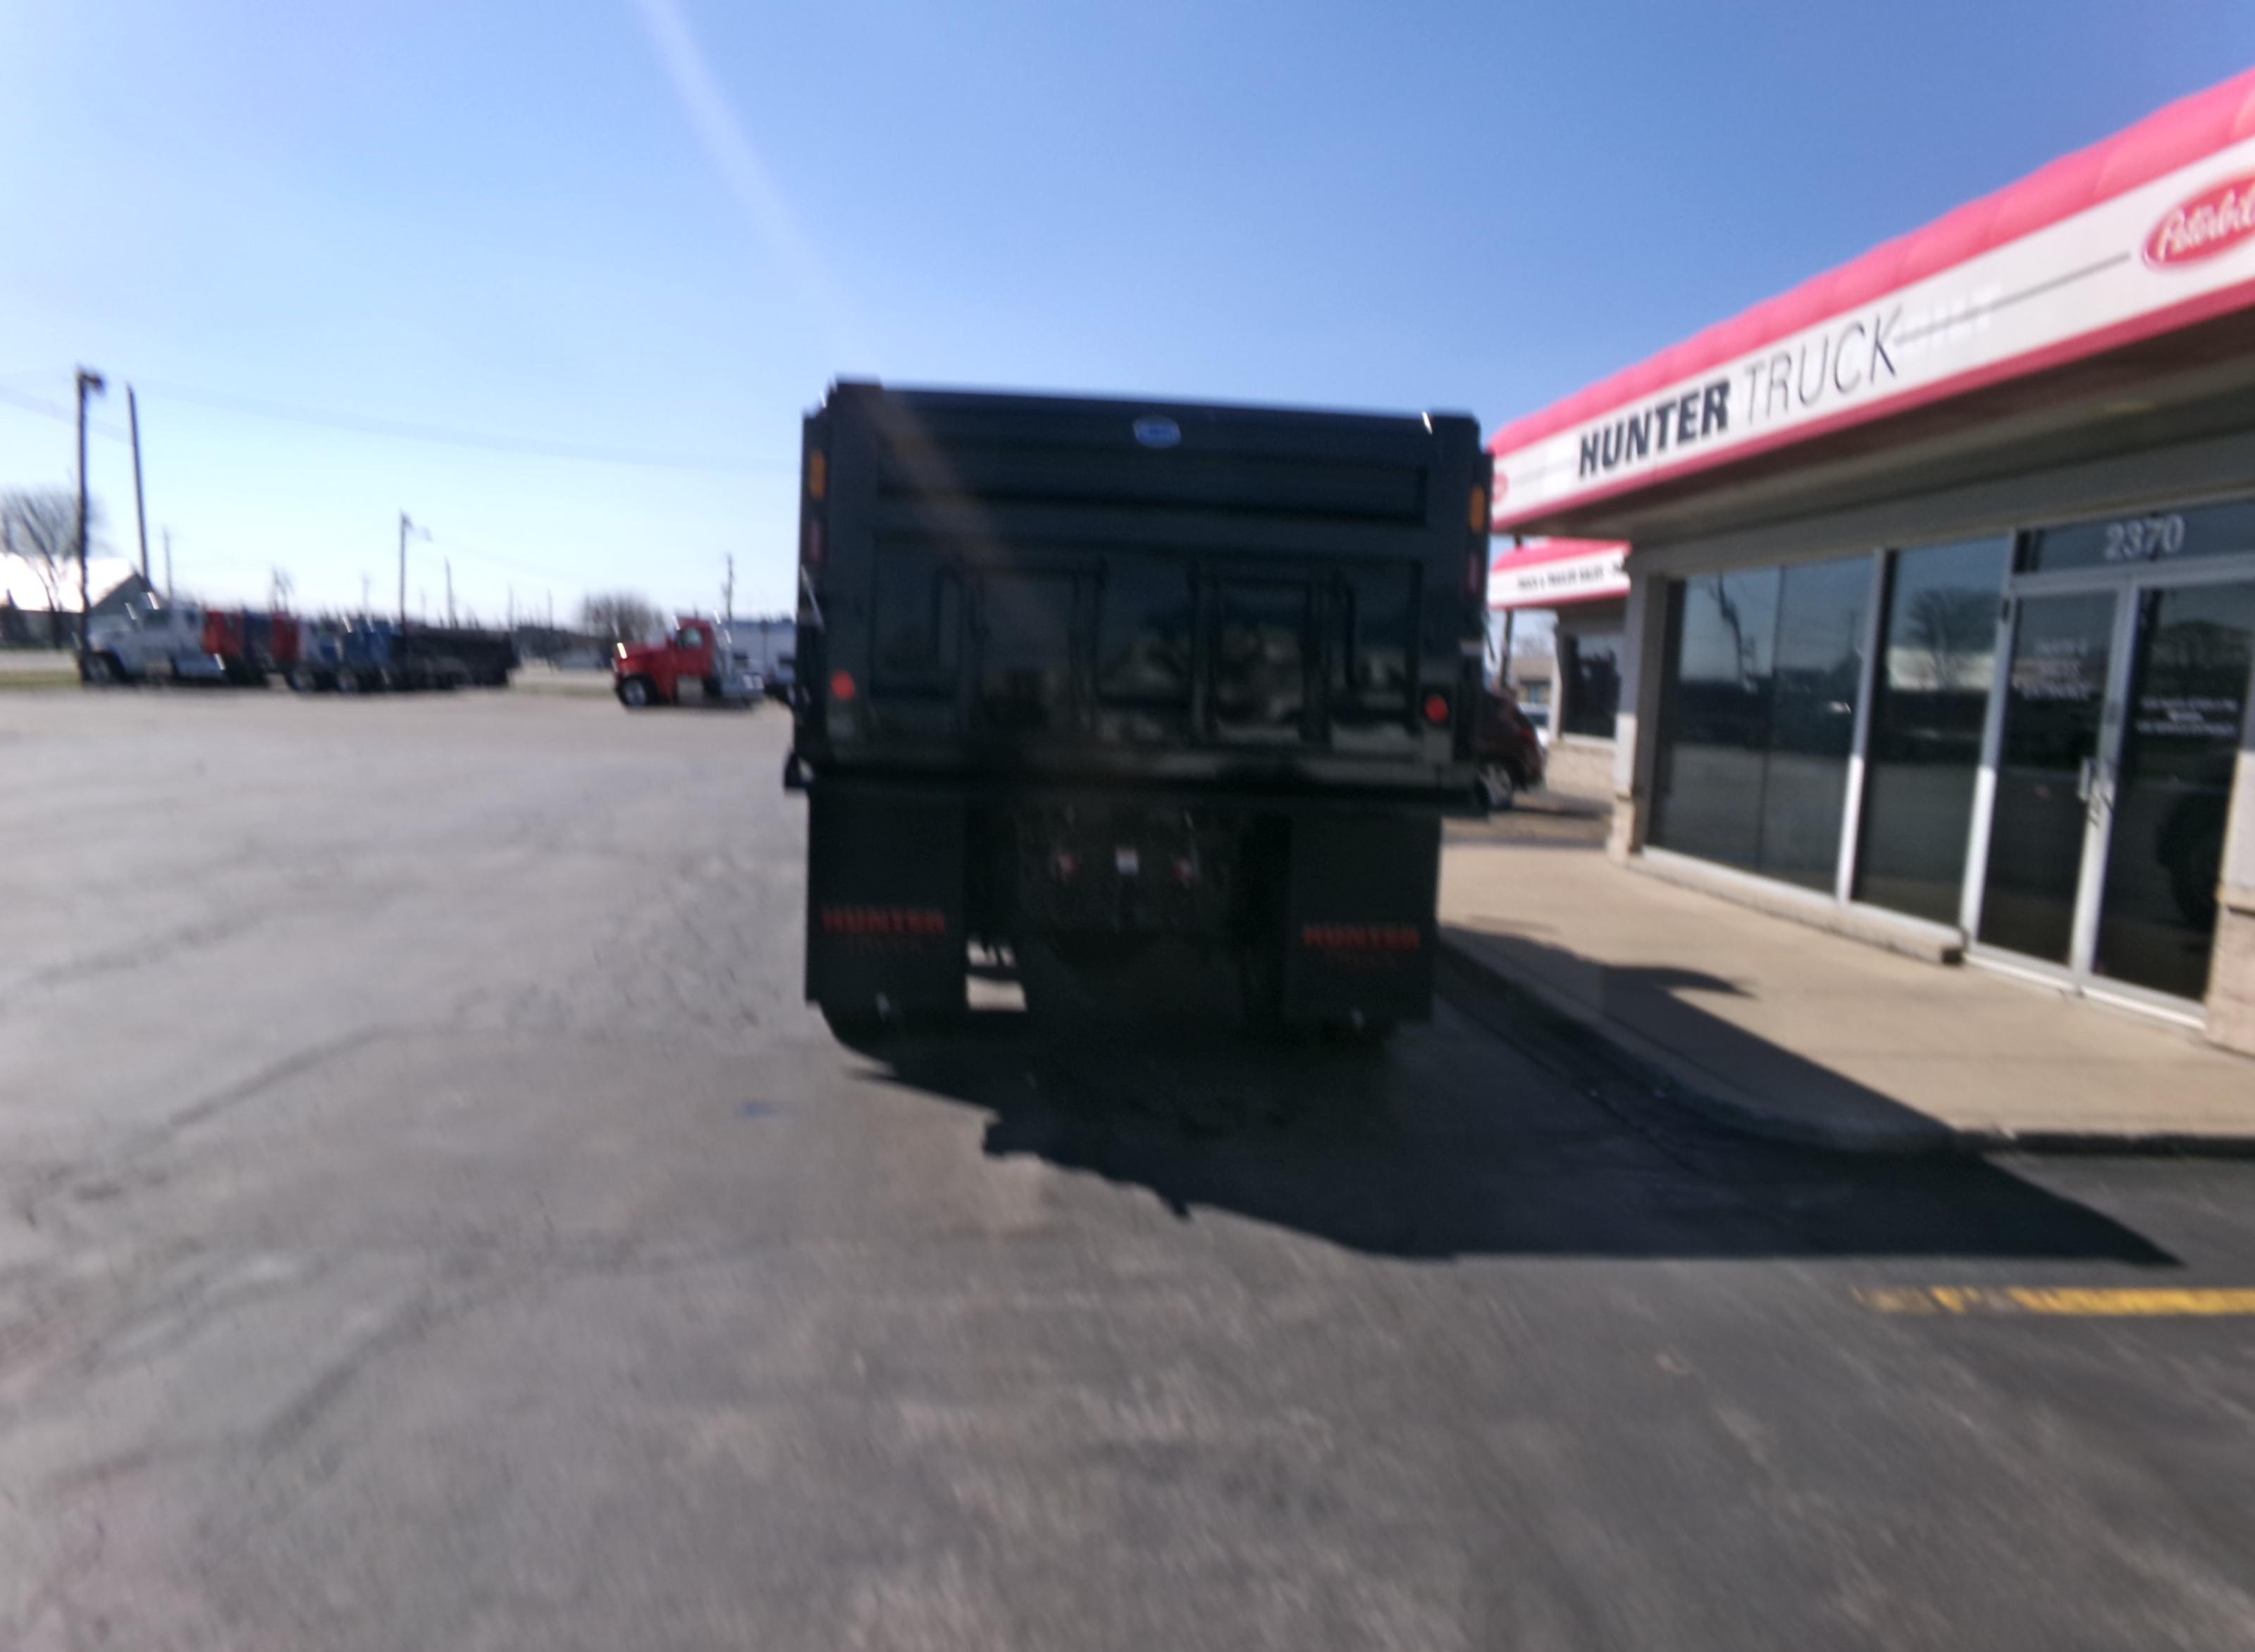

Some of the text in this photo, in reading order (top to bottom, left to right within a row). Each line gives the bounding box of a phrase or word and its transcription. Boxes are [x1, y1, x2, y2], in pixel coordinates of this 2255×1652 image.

[1578, 378, 1731, 478] HUNTER
[1744, 306, 1902, 425] TRUCK
[2105, 514, 2184, 561] 2370
[822, 906, 945, 934] HUNTER
[1301, 923, 1419, 948] HUNTER
